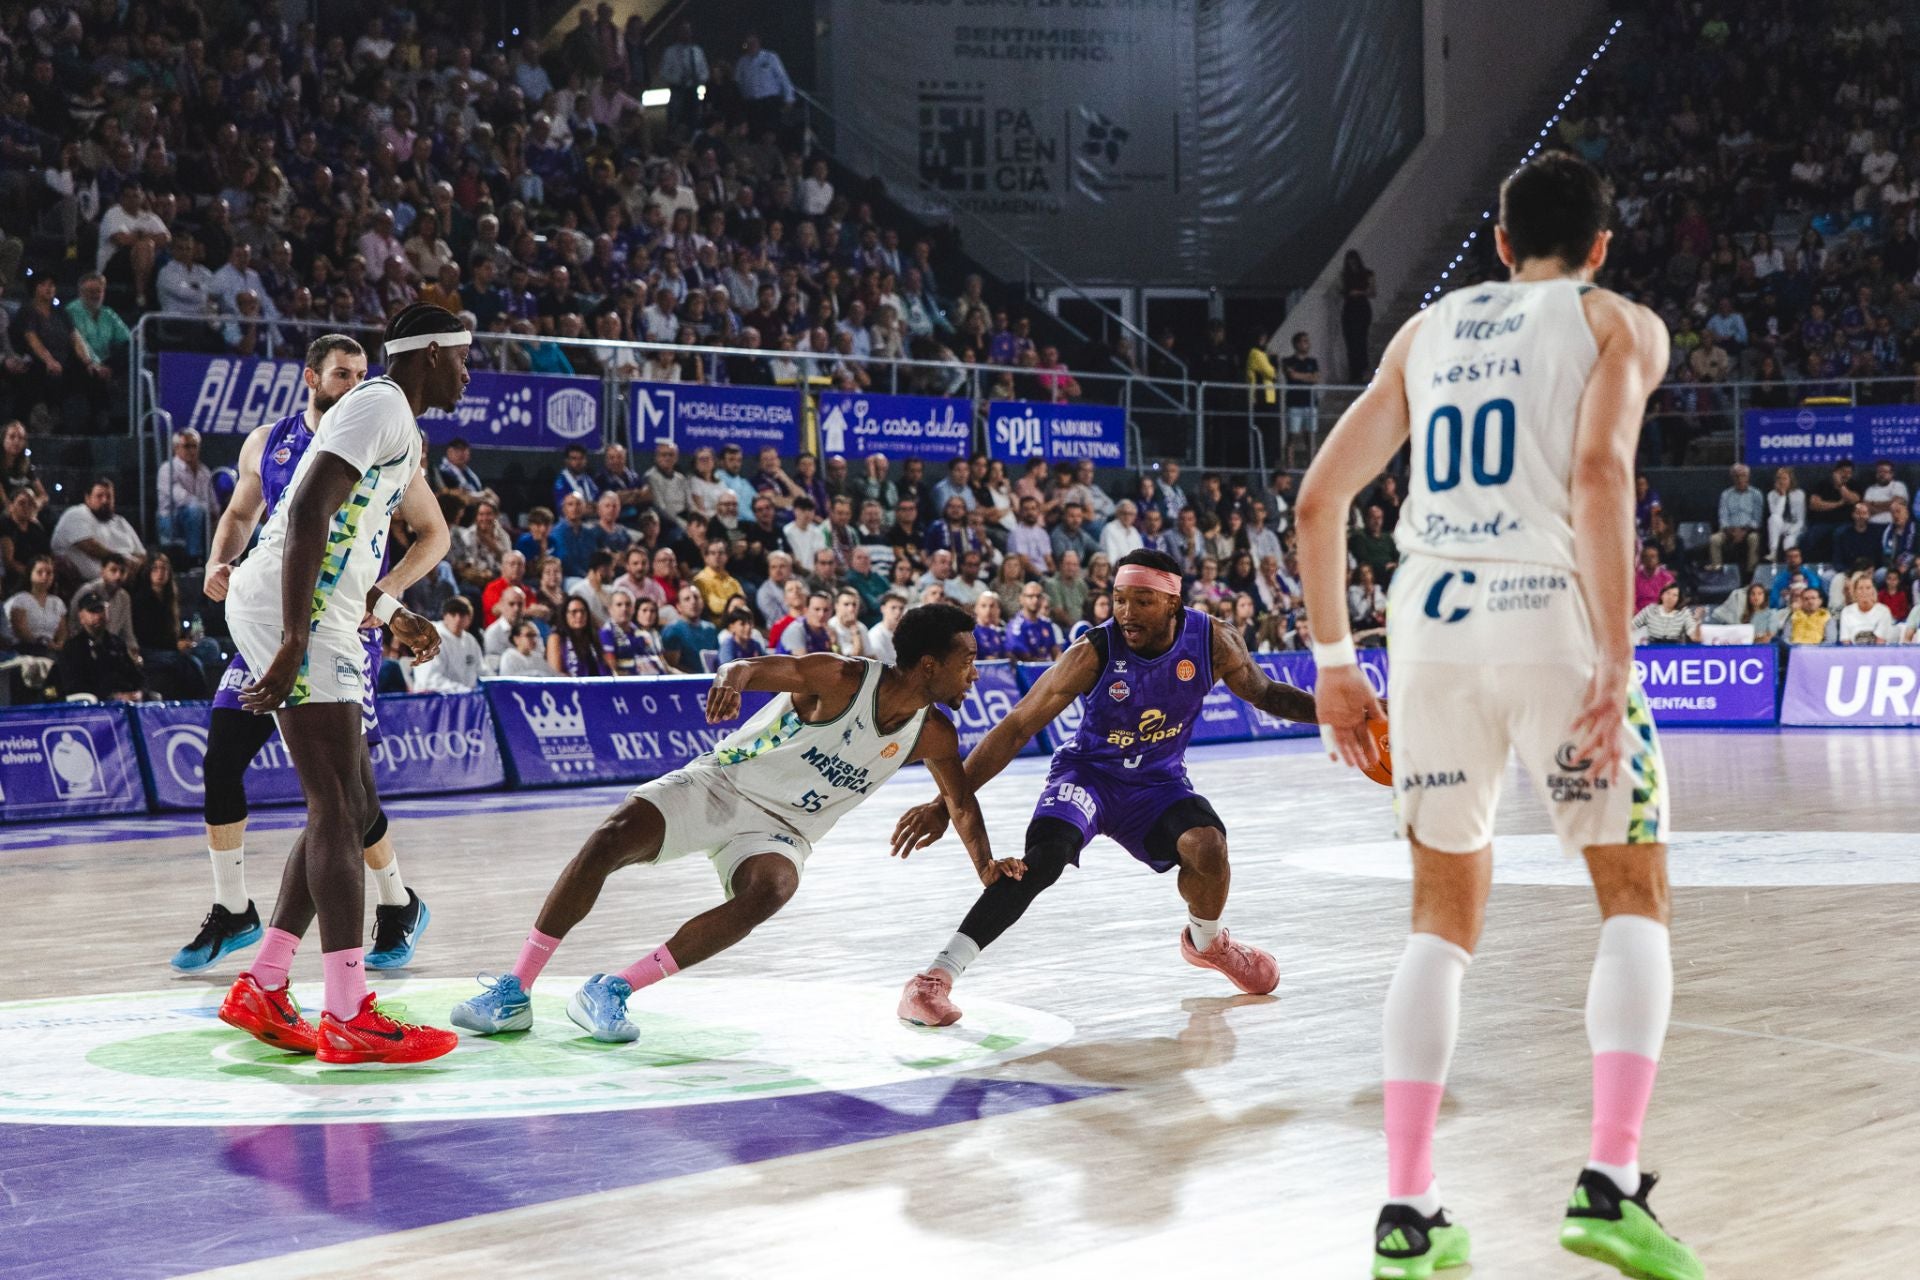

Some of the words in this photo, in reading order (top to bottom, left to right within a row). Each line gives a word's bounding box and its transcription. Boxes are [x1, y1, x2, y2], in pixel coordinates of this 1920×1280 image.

[993, 108, 1035, 135] PA
[994, 138, 1056, 163] LEN
[993, 167, 1051, 192] CIA
[679, 401, 794, 425] MORALESCERVERA
[882, 417, 923, 437] casa
[924, 404, 970, 439] dulce
[1426, 398, 1515, 492] 00
[1760, 434, 1812, 450] DONDE
[1814, 432, 1854, 447] DANI
[1489, 574, 1567, 594] carreras
[1487, 593, 1552, 613] center
[612, 692, 709, 716] HOTE
[610, 730, 663, 761] REY
